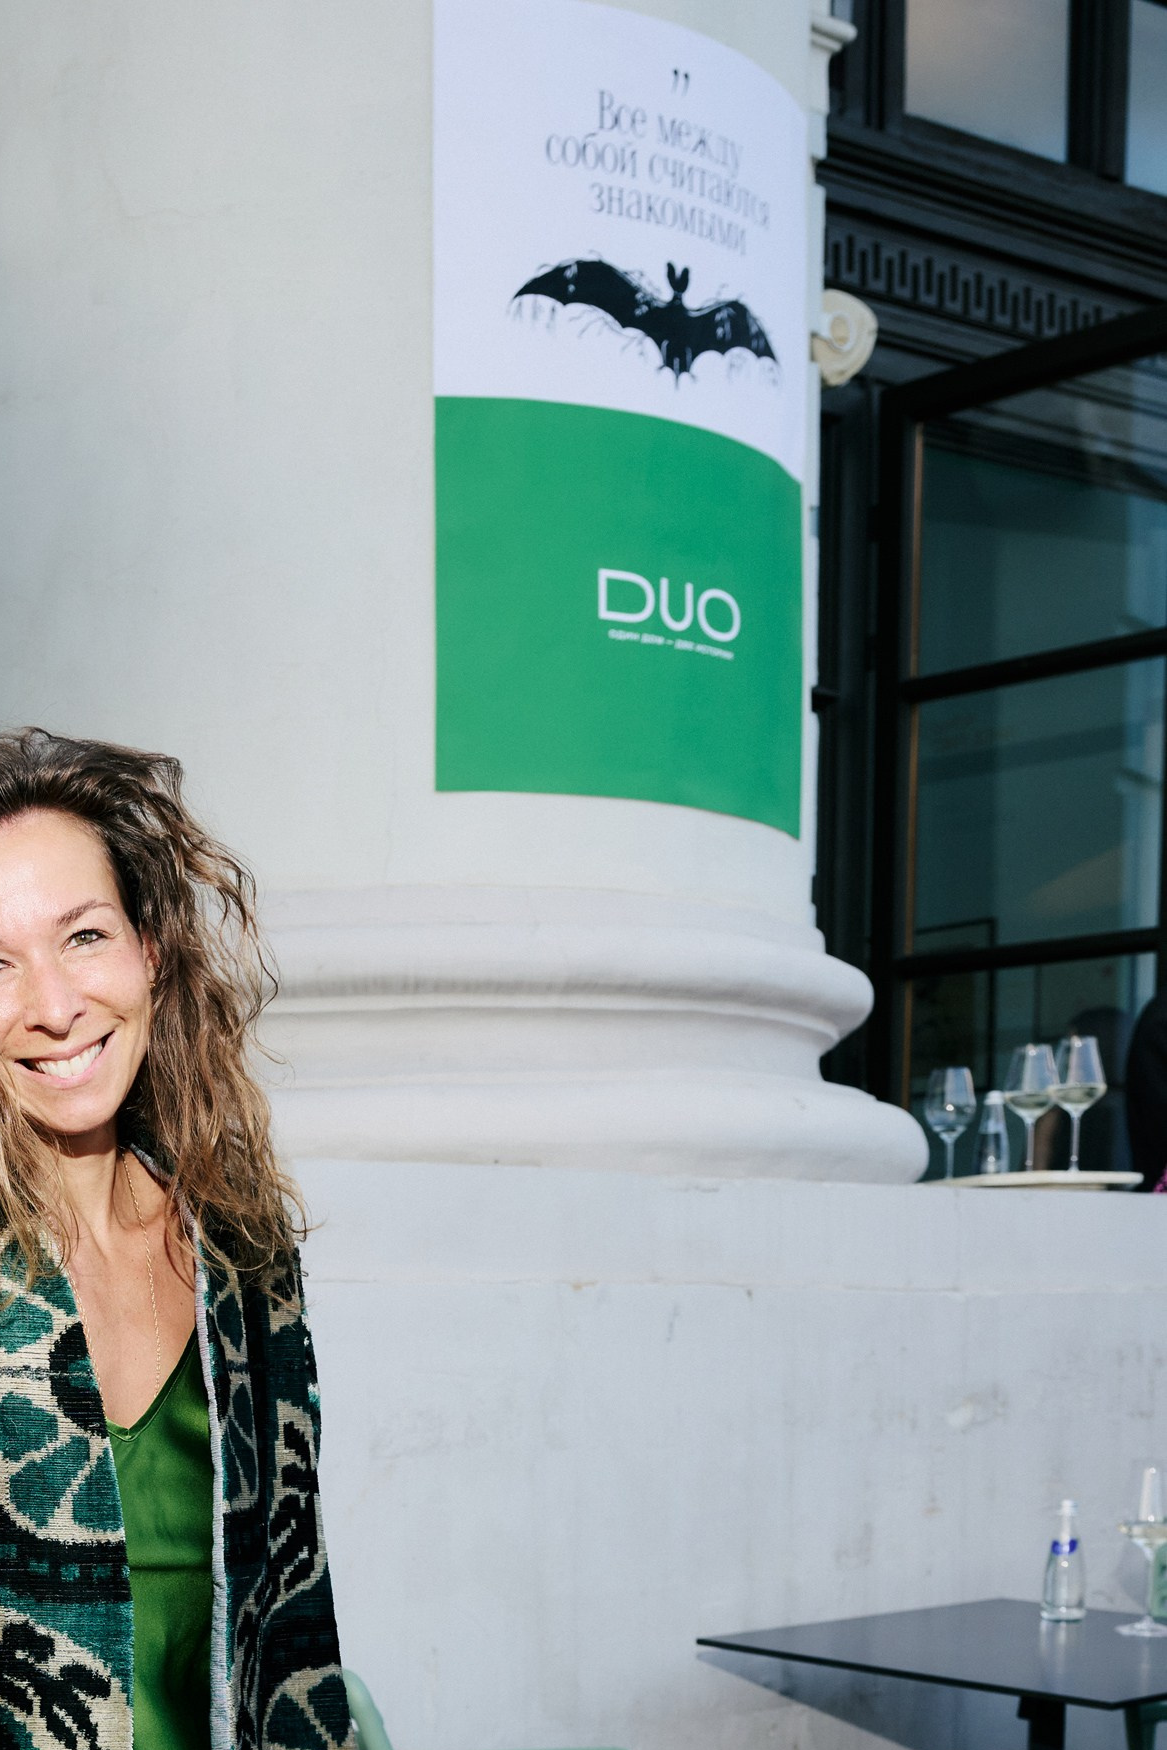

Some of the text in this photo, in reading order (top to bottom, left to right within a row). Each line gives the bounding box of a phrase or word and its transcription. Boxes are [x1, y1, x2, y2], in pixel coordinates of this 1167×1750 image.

[545, 131, 637, 179] собой
[598, 89, 743, 180] Все между
[588, 181, 746, 256] знакомыми
[598, 568, 741, 642] DUO
